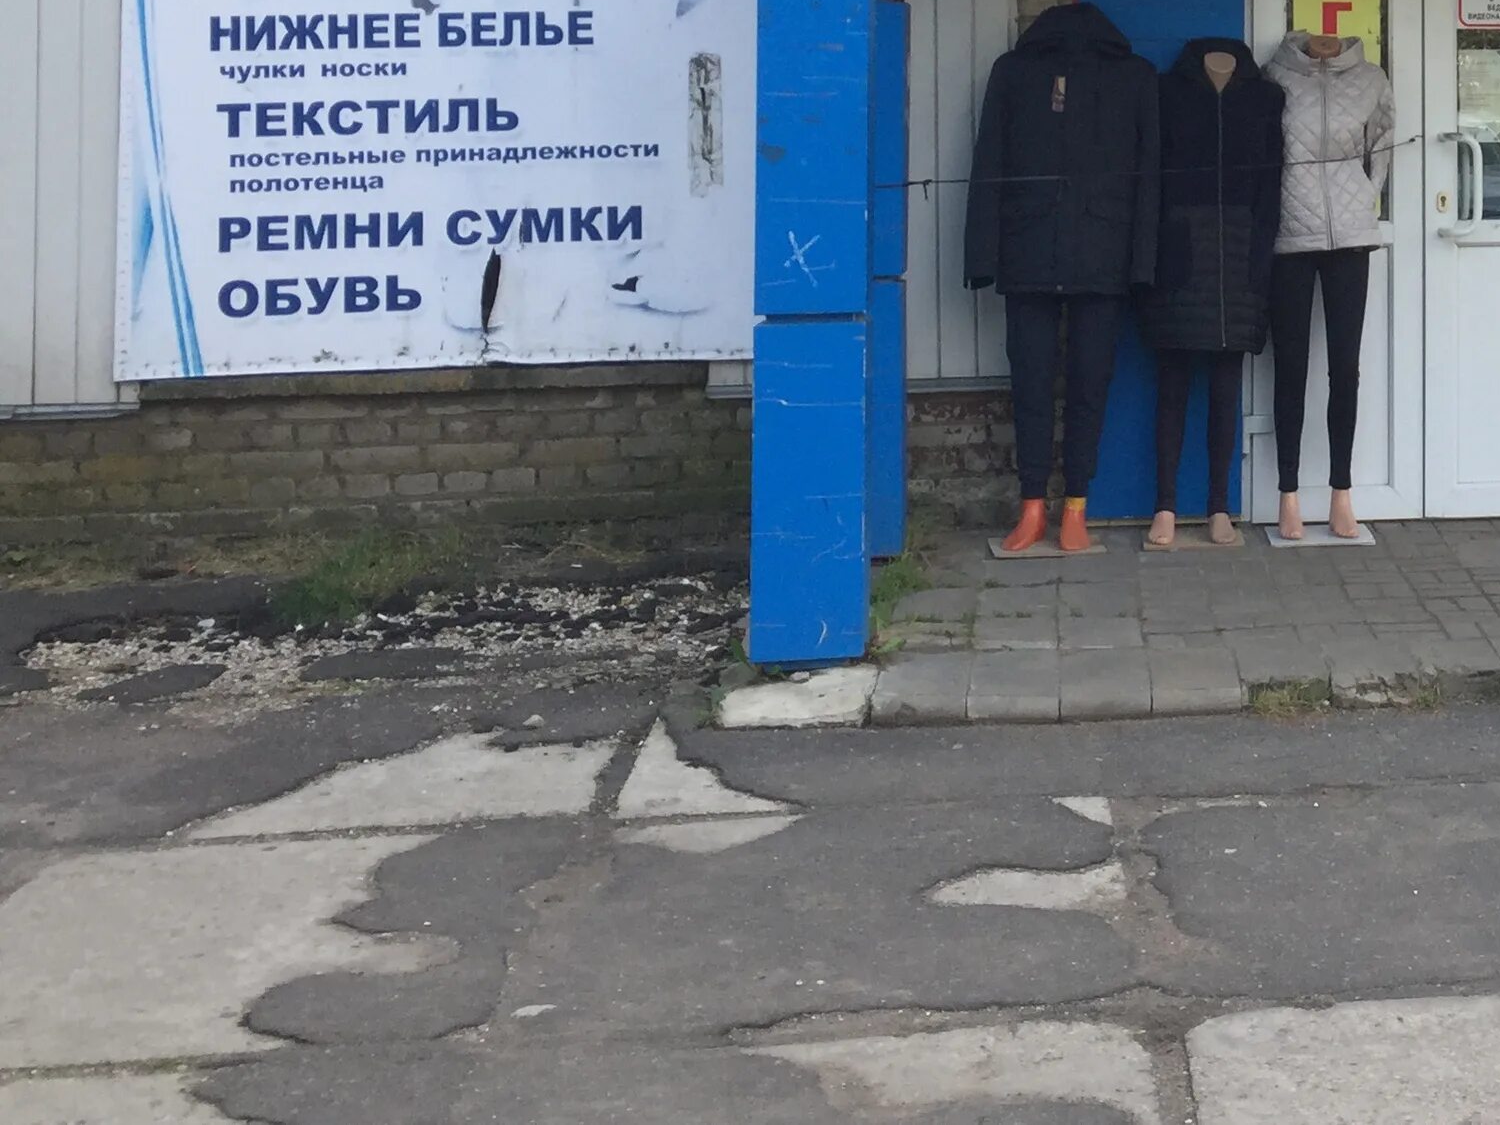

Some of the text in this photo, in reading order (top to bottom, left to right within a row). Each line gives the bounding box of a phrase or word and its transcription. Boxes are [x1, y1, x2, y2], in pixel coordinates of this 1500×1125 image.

[209, 10, 595, 52] НИЖНЕЕ БЕЛЬЕ
[219, 60, 408, 84] чулки носки
[216, 97, 520, 138] ТЕКСТИЛЬ
[228, 141, 660, 169] постельные принадлежности
[228, 174, 385, 194] полотенца
[217, 205, 644, 253] РЕМНИ СУМКИ
[216, 275, 423, 318] ОБУВЬ
